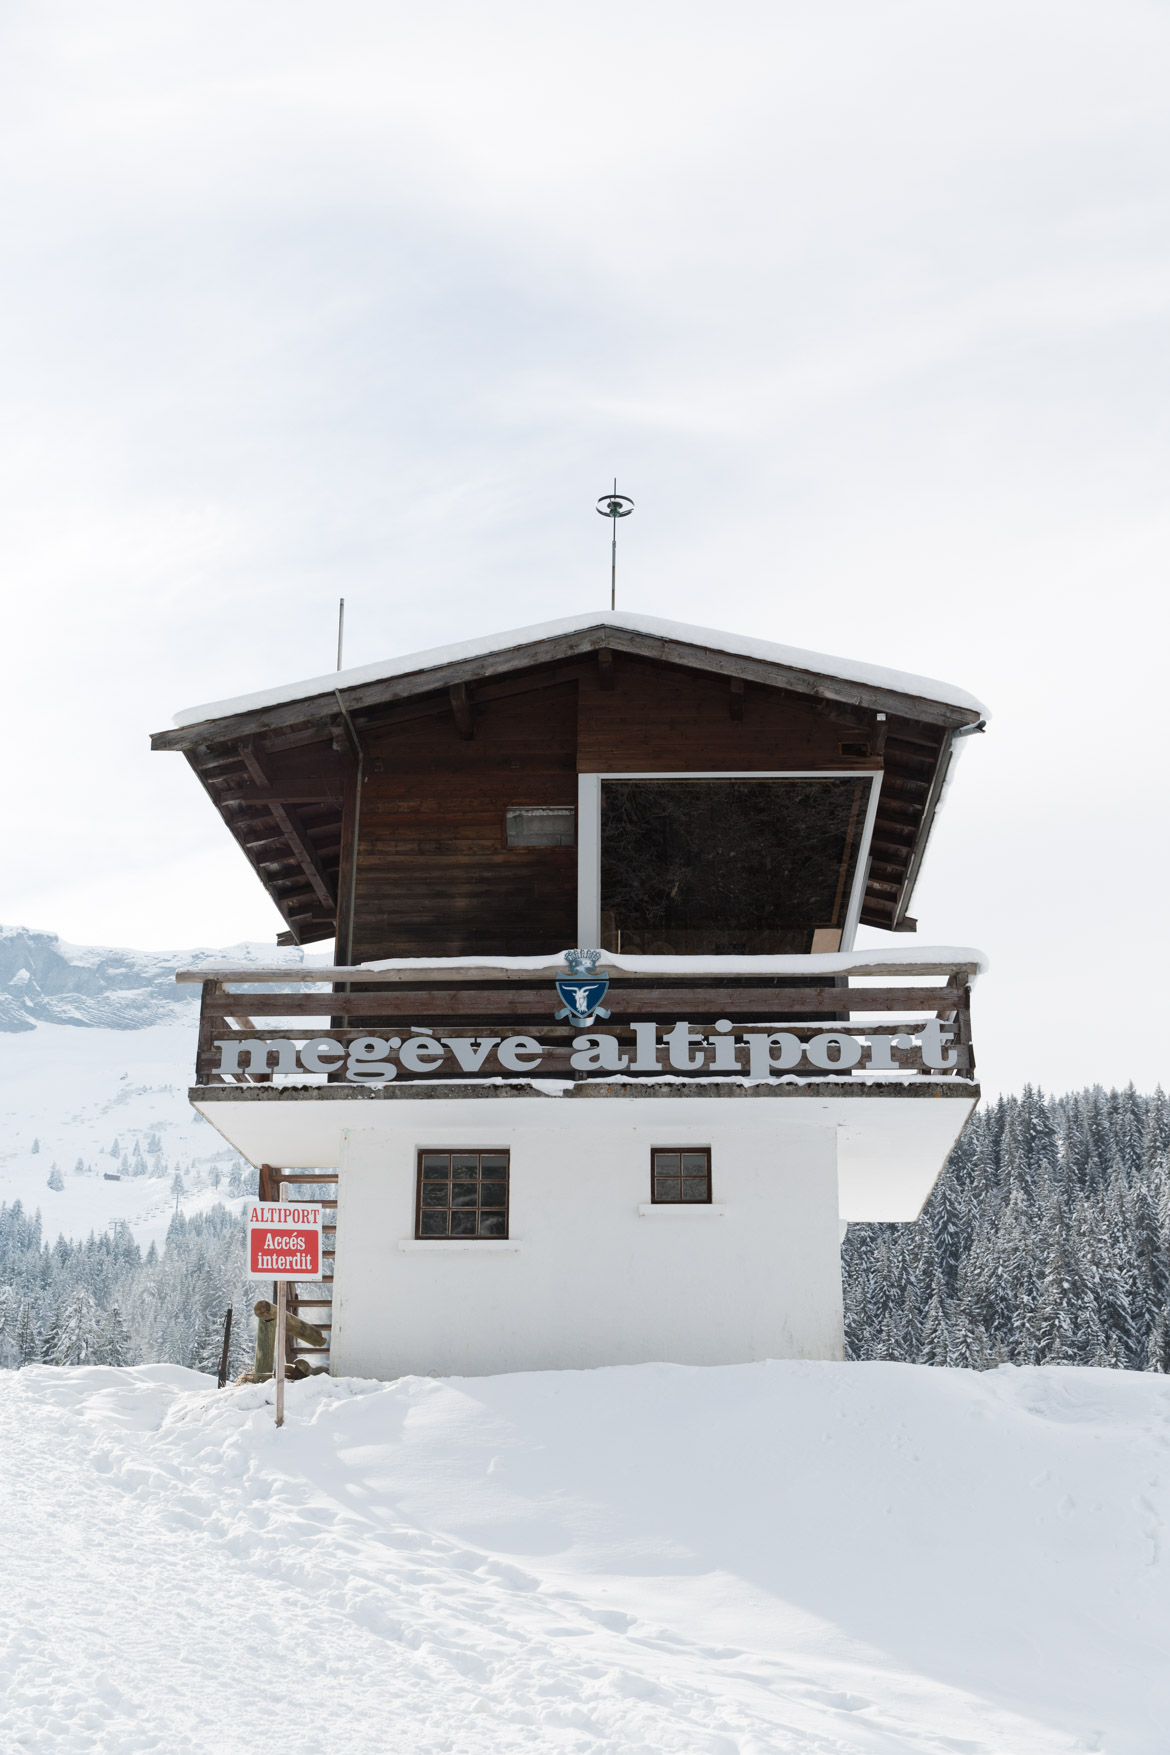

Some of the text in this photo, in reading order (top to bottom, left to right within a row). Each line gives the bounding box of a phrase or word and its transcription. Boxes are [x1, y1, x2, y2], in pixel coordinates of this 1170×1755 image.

[212, 1018, 958, 1083] megève altiport
[250, 1207, 320, 1224] ALTIPORT
[263, 1231, 306, 1250] Accés
[257, 1252, 313, 1270] interdit
